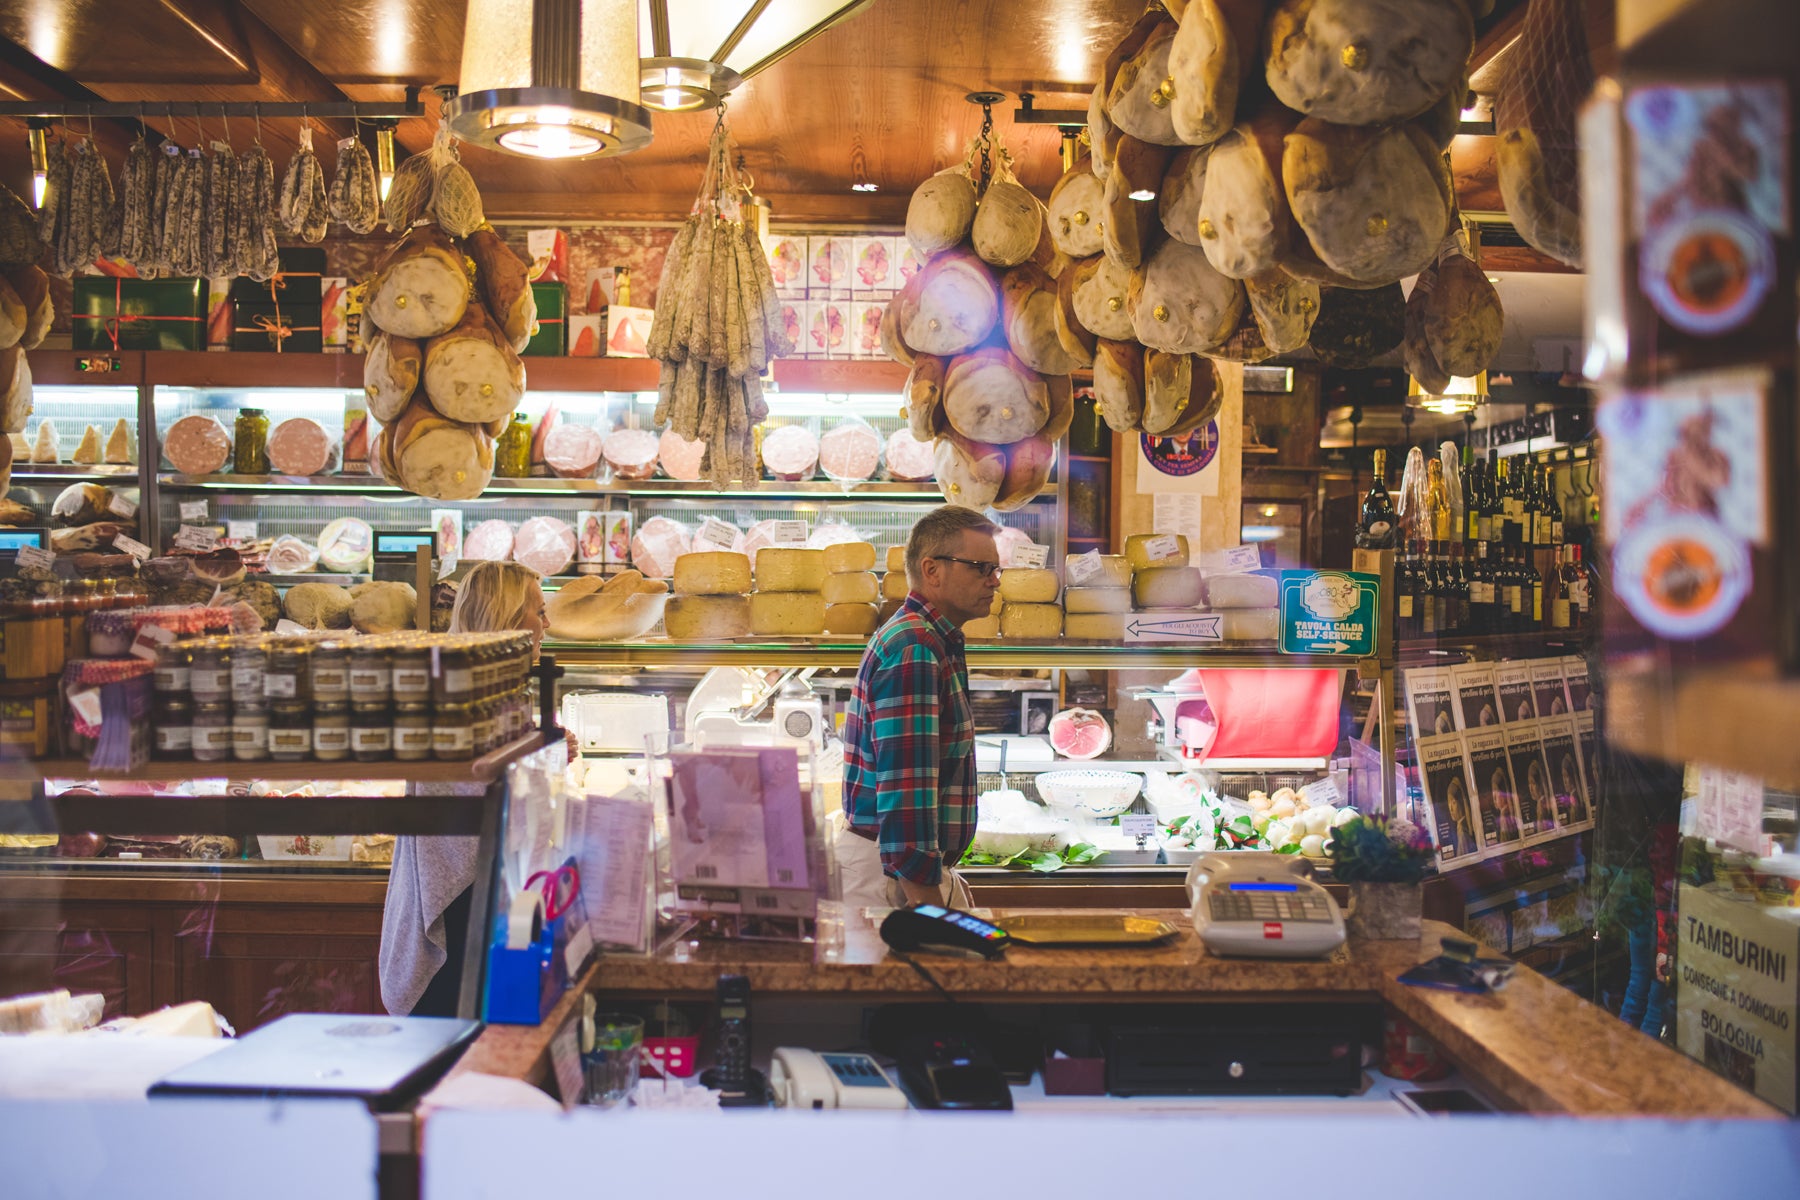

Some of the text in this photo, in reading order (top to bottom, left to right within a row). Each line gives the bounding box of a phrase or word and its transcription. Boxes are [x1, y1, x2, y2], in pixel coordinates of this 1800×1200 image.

[1295, 621, 1364, 632] TAVOLA CALDA
[1296, 630, 1362, 641] SELF-SERVICE
[1468, 676, 1482, 686] ragazza
[1478, 740, 1493, 749] ragazza
[1434, 749, 1450, 759] ragazza
[1687, 916, 1786, 983] TAMBURINI
[1683, 965, 1790, 1030] CONSEGNE A DOMICILIO
[1700, 1008, 1765, 1060] BOLOGNA
